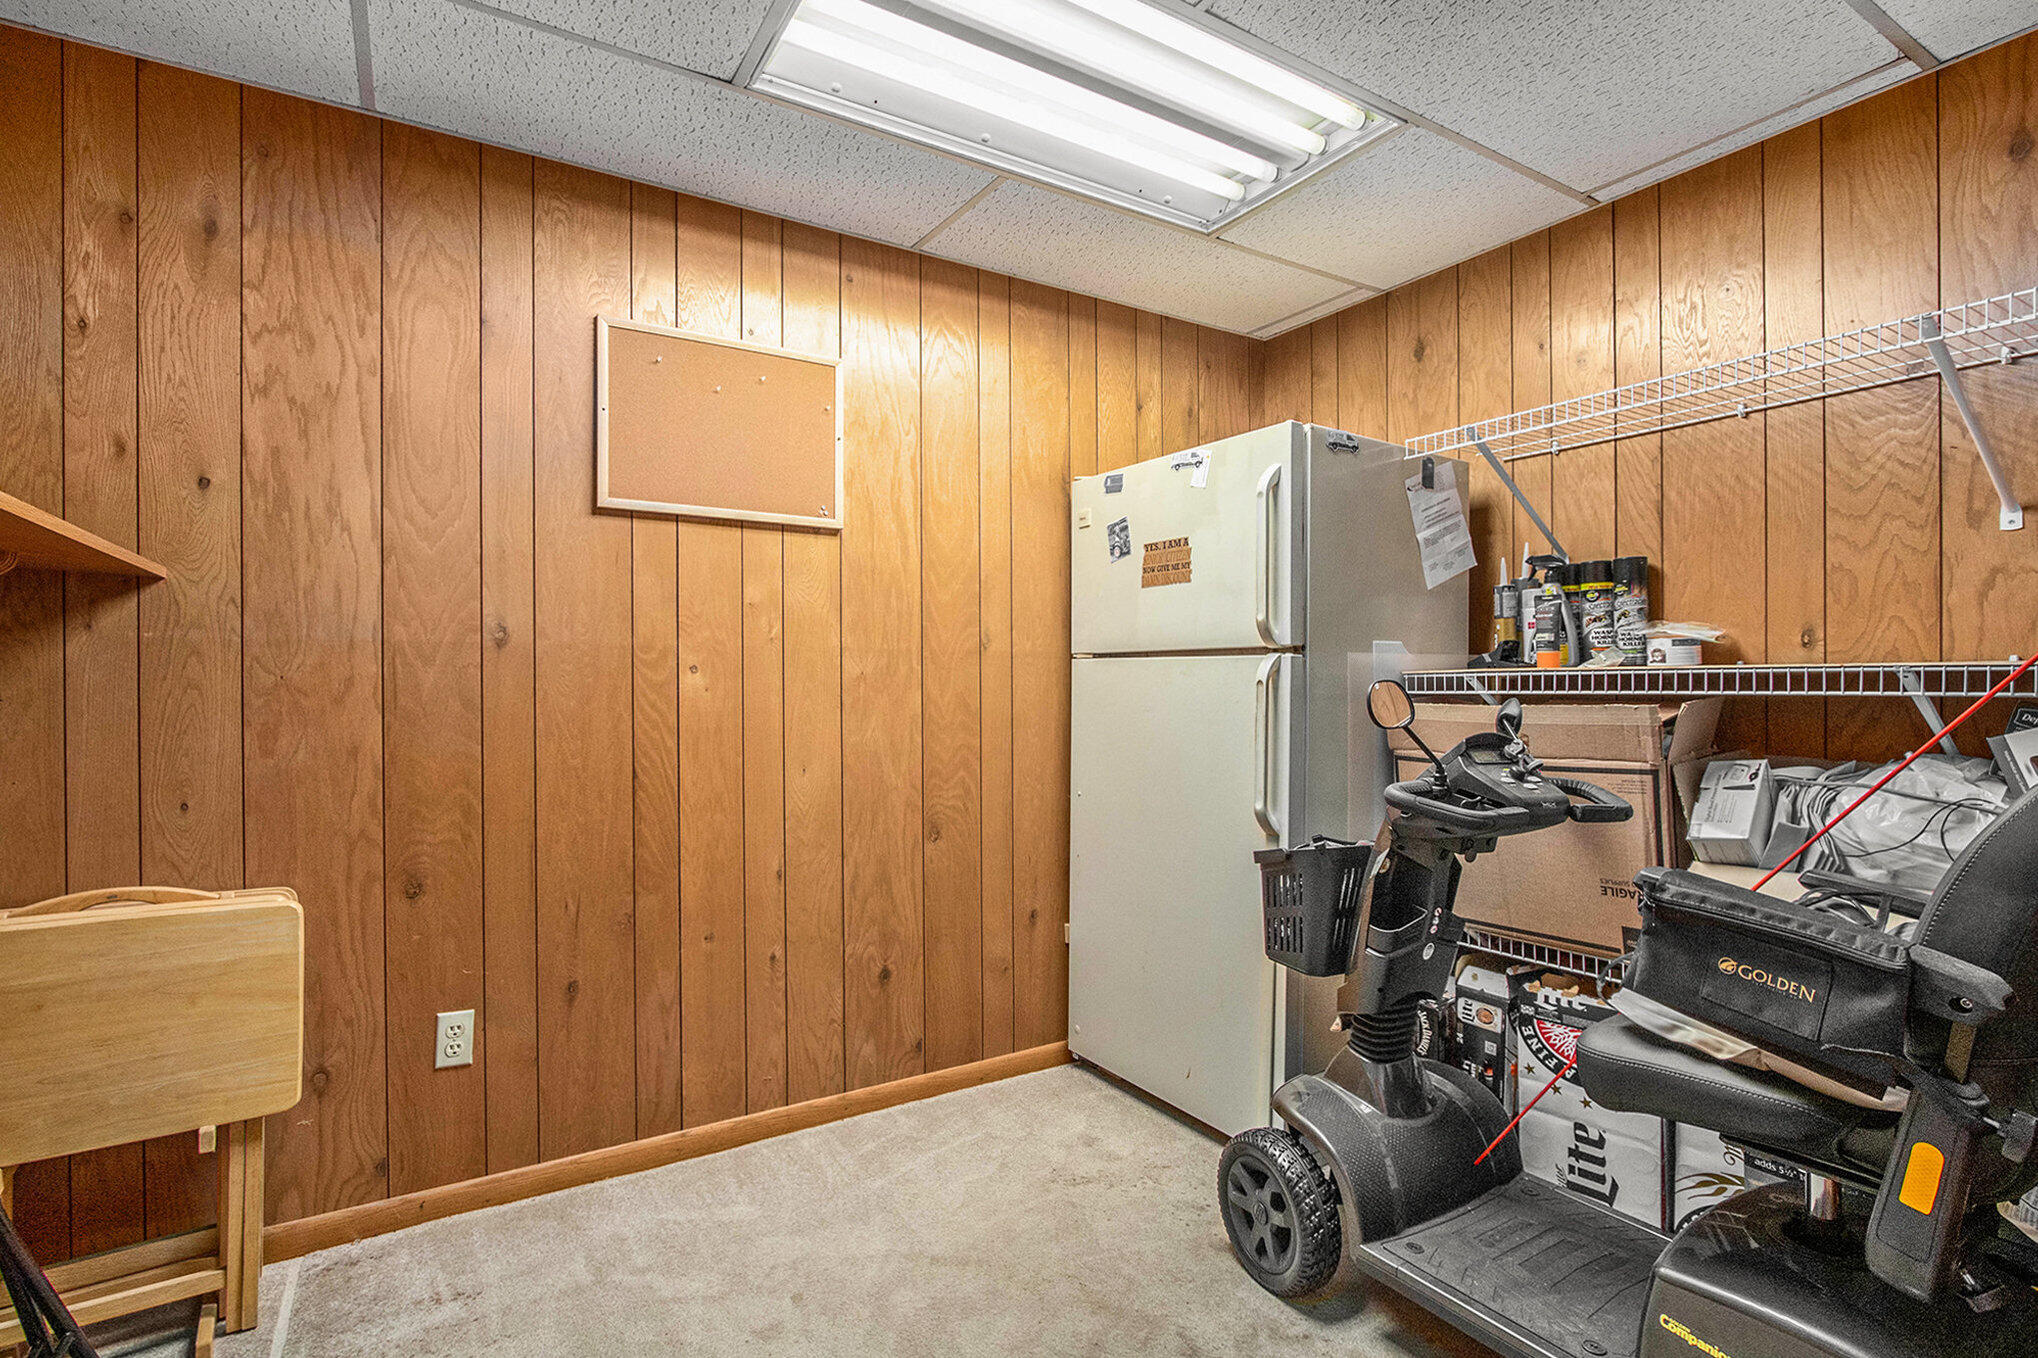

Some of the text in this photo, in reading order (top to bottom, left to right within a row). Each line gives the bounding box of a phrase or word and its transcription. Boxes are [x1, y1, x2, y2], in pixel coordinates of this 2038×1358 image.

[1168, 539, 1181, 549] AM
[1182, 537, 1189, 546] A
[1143, 562, 1191, 574] NOW GIVE ME MY
[1738, 964, 1816, 1003] GOLDEN
[1417, 1010, 1431, 1029] JACK
[1521, 1024, 1559, 1070] FINE
[1566, 1121, 1620, 1208] Lite
[1754, 1158, 1777, 1172] adds
[1659, 1313, 1732, 1358] Companio
